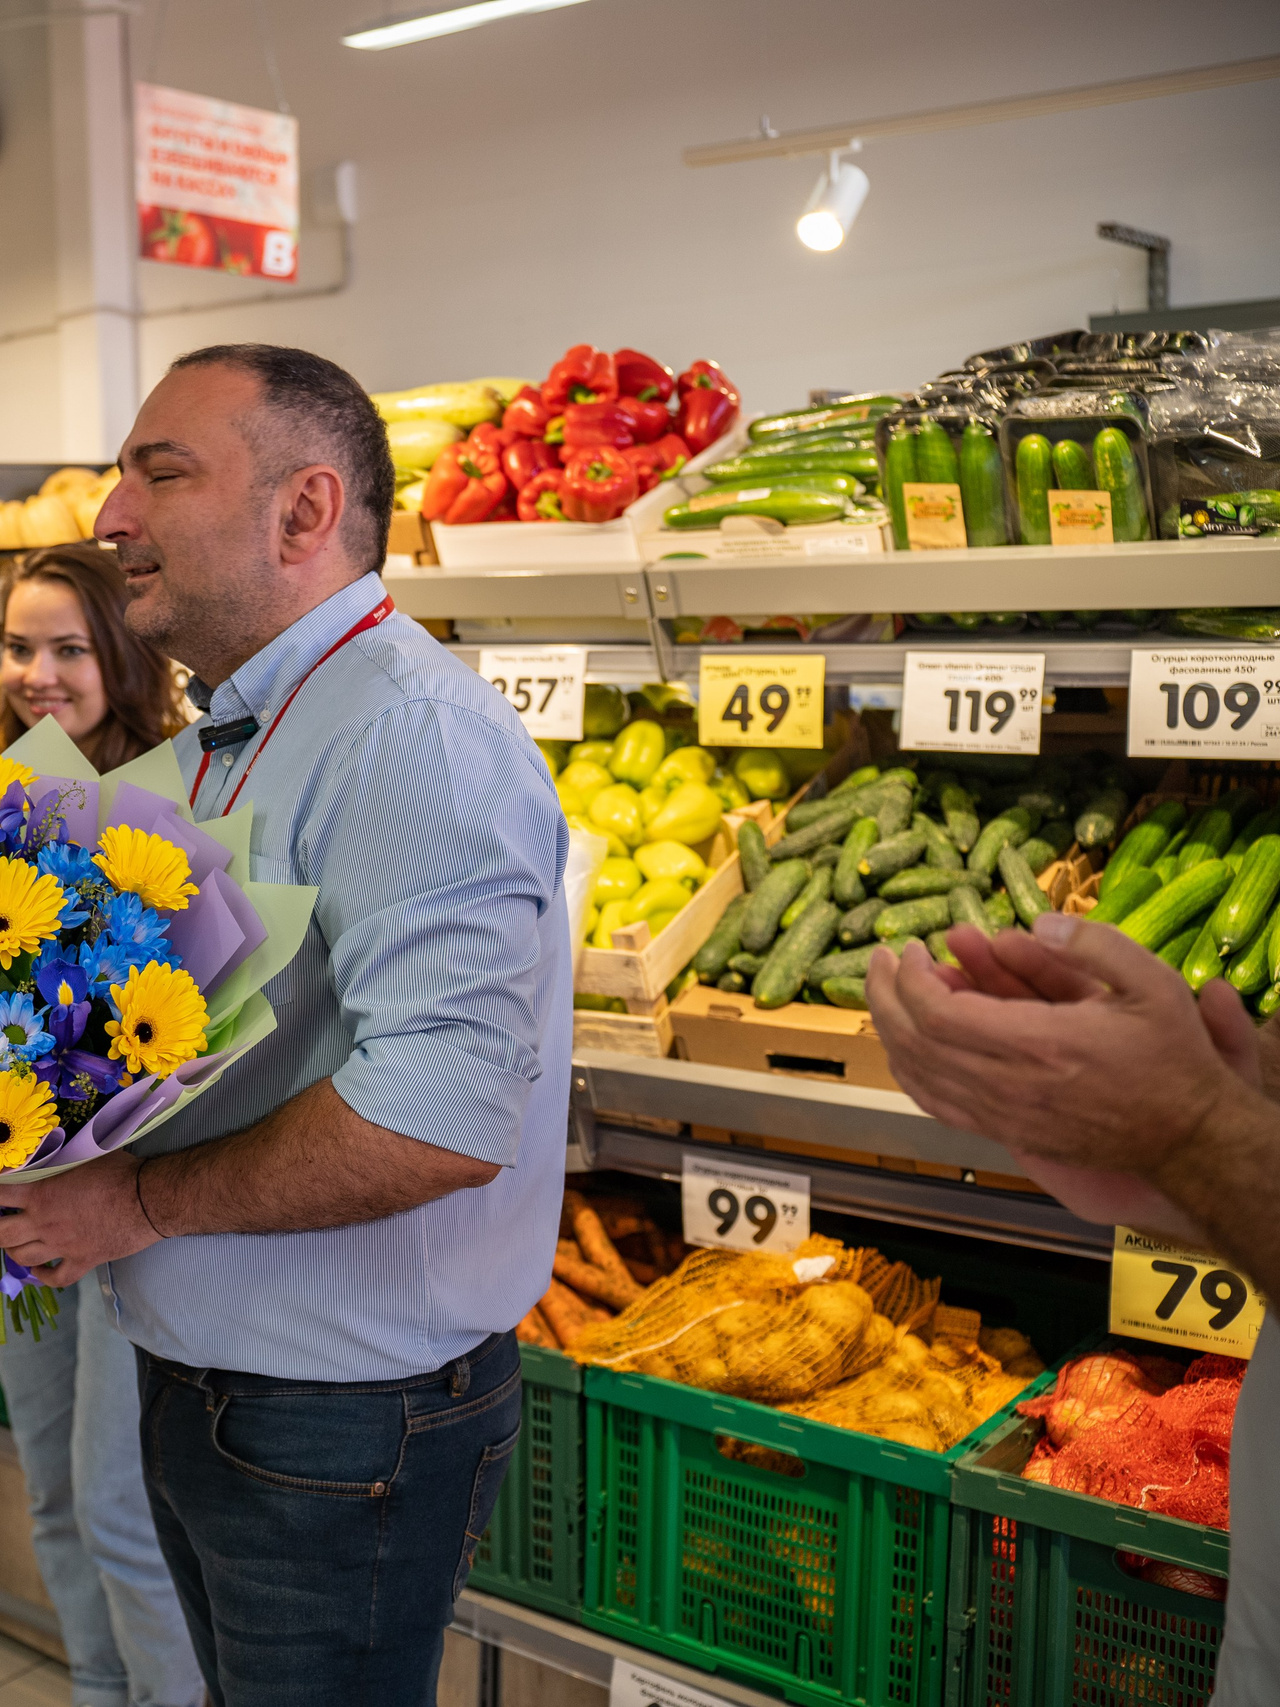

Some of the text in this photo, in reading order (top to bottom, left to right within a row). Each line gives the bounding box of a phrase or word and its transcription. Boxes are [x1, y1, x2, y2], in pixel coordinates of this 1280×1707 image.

[1151, 654, 1276, 664] Огурцы короткоплодные
[1169, 665, 1258, 675] фасованные 450г
[722, 684, 790, 733] 49
[944, 688, 1038, 734] 119 99
[1159, 682, 1261, 730] 109
[708, 1188, 777, 1245] 99
[781, 1203, 798, 1217] 99
[1151, 1260, 1248, 1331] 79
